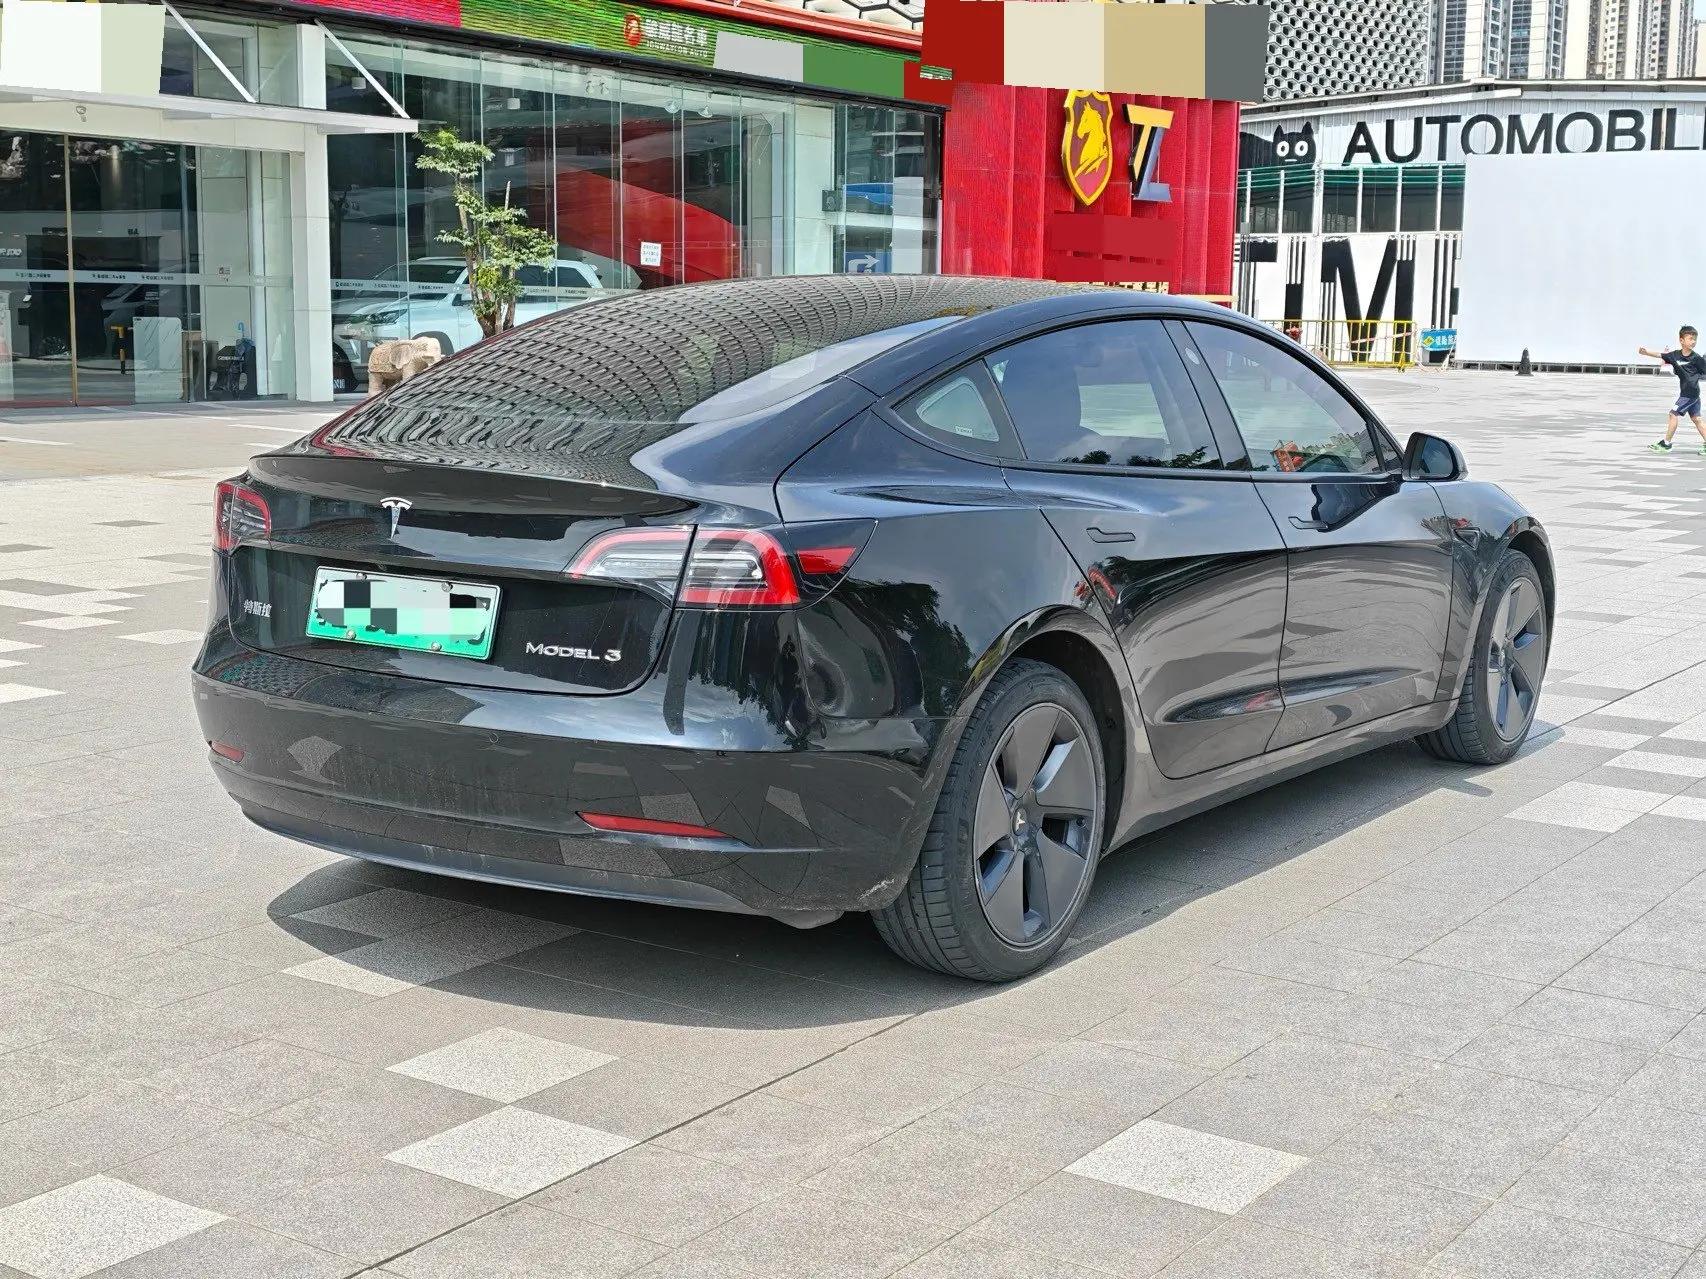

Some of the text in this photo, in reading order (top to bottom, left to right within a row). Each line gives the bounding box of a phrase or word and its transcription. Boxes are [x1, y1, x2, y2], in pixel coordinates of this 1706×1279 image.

[1341, 106, 1706, 167] AUTOMOBIL
[525, 641, 622, 662] MODEL 3
